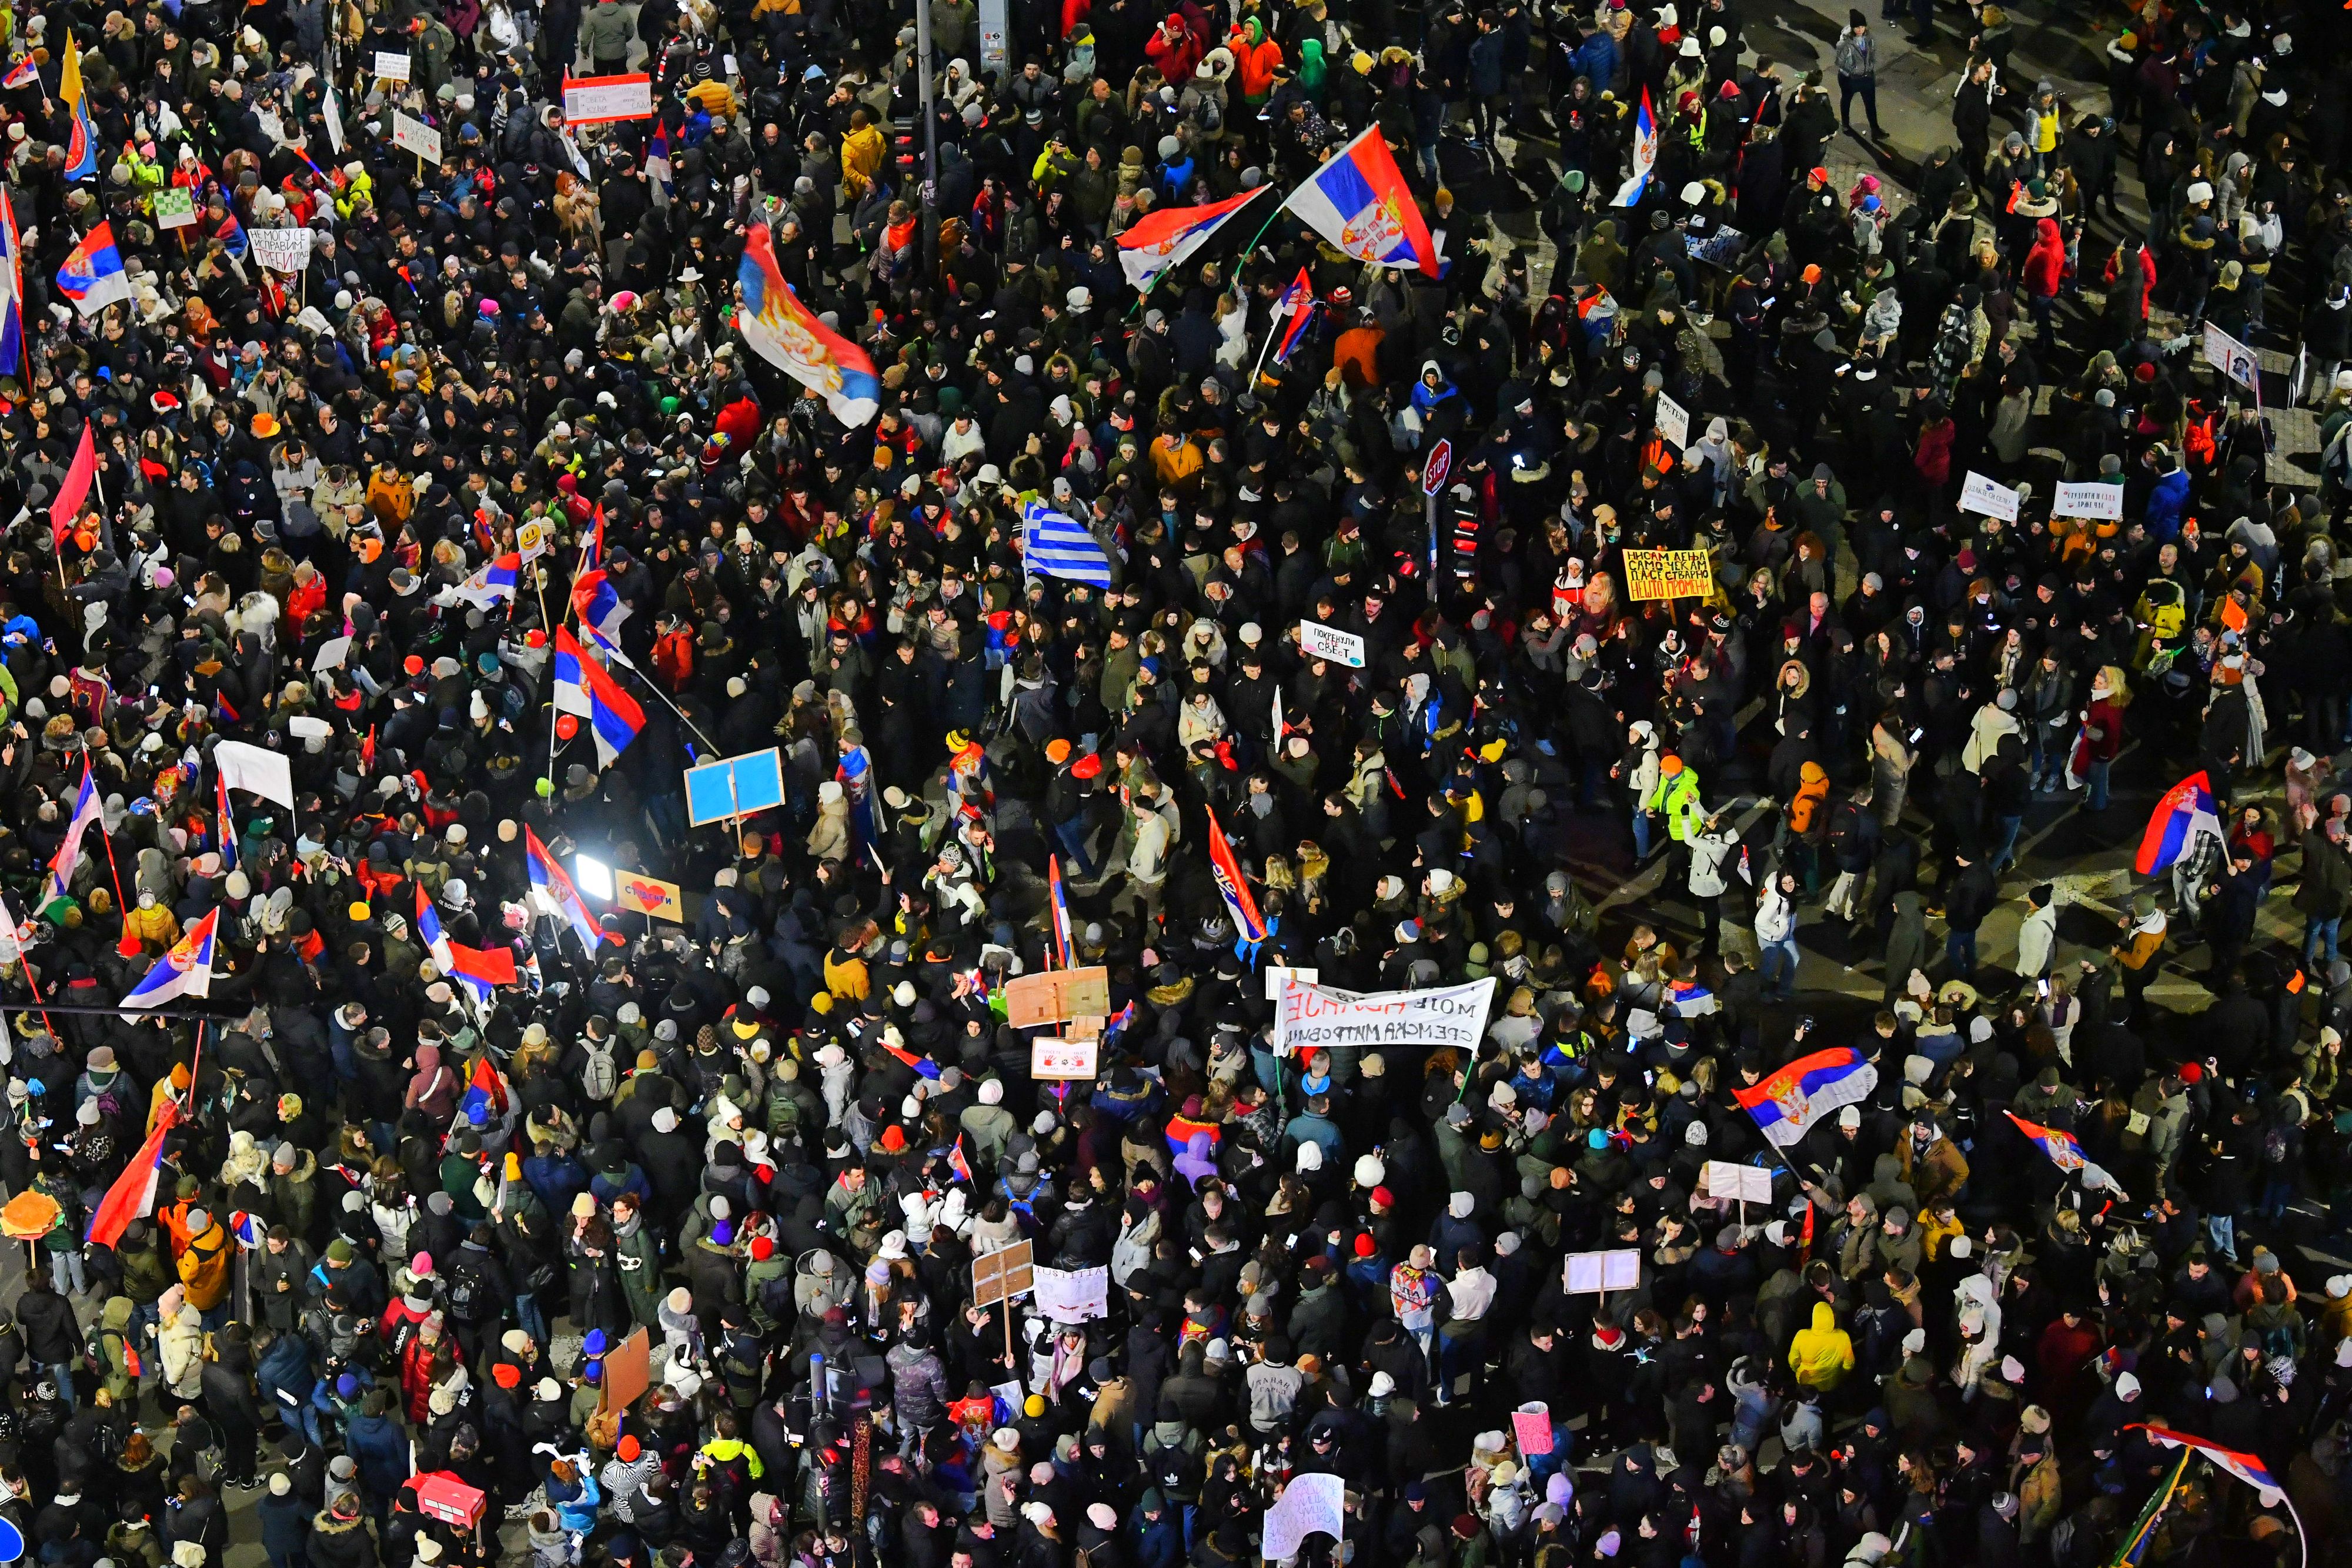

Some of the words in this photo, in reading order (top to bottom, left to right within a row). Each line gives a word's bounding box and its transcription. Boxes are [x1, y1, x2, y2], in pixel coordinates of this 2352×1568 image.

[250, 229, 262, 239] НЕ
[264, 230, 290, 241] МОГУ
[294, 229, 305, 241] СЕ
[255, 239, 302, 251] ИСПРАВИМ
[254, 248, 292, 270] ТРЕЋИ
[1428, 452, 1448, 484] STOP
[1967, 484, 1987, 497] ОДАКЛЕ
[2102, 493, 2116, 502] САДА
[1627, 550, 1669, 561] НИСАМ
[1674, 551, 1706, 561] ЛЕЊА
[1628, 560, 1663, 571] САМО
[1666, 560, 1708, 571] ЧЕКАМ
[1631, 570, 1648, 581] ДА
[1649, 570, 1663, 581] СЕ
[1665, 569, 1709, 581] СТВАРНО
[1631, 580, 1665, 600] НЕШТО
[1666, 579, 1710, 598] ПРОМЕНИ
[1314, 628, 1355, 647] ПОКРЕНУЛИ
[624, 885, 671, 905] СТУДЕНТИ
[444, 902, 463, 912] SQUAD
[1035, 1268, 1102, 1279] IUSTITIA
[394, 1325, 408, 1355] adidas
